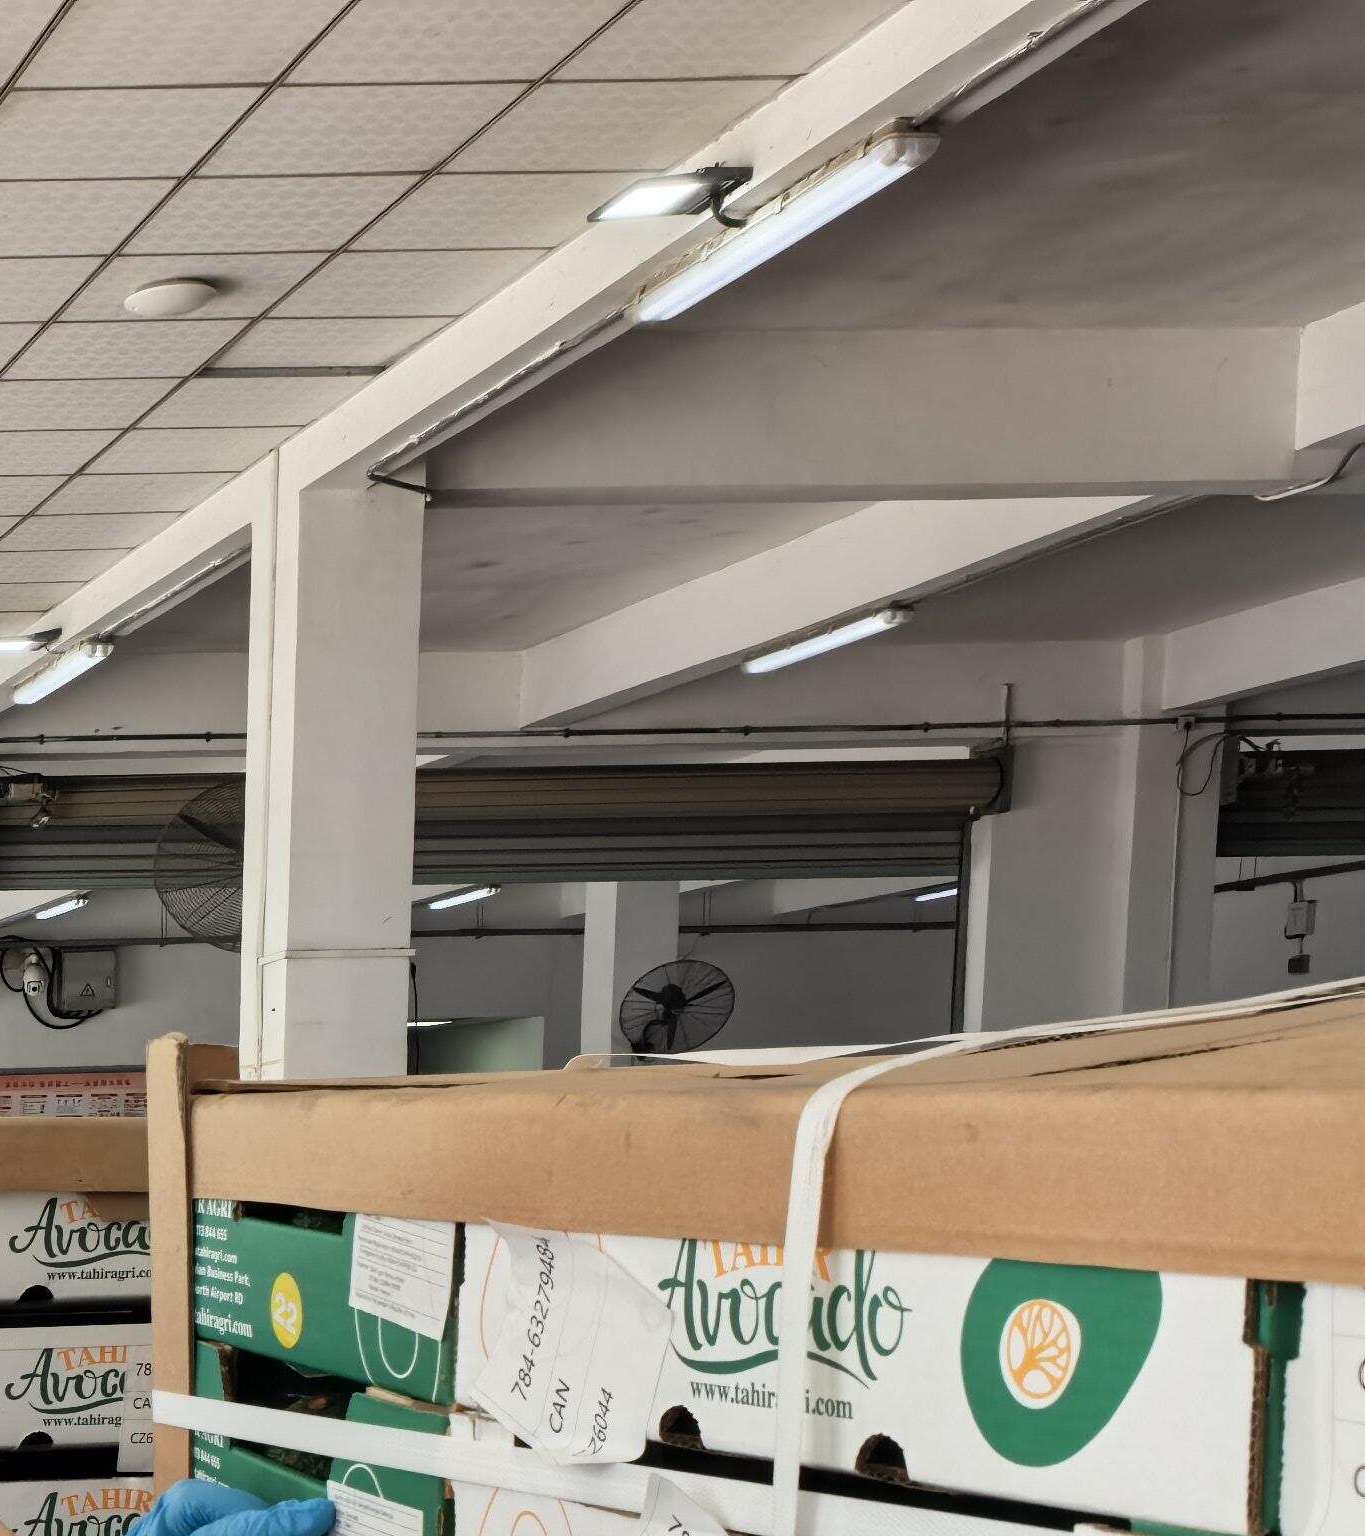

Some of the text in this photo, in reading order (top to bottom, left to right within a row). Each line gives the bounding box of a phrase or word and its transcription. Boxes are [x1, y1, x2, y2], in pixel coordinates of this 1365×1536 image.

[9, 1197, 151, 1257] Avoca
[47, 1267, 151, 1282] www.tahiragri.co
[195, 1285, 210, 1298] orth
[195, 1308, 253, 1338] tahiragri.com
[511, 1236, 555, 1401] 784-63279484
[57, 1345, 127, 1372] TAHI
[4, 1348, 126, 1406] Avoc
[133, 1397, 151, 1411] CA
[549, 1378, 571, 1434] CAN
[690, 1381, 854, 1420] www.tahiri.com
[42, 1413, 122, 1428] www.tahirag
[586, 1386, 614, 1455] Z6044
[130, 1431, 153, 1445] CZ6
